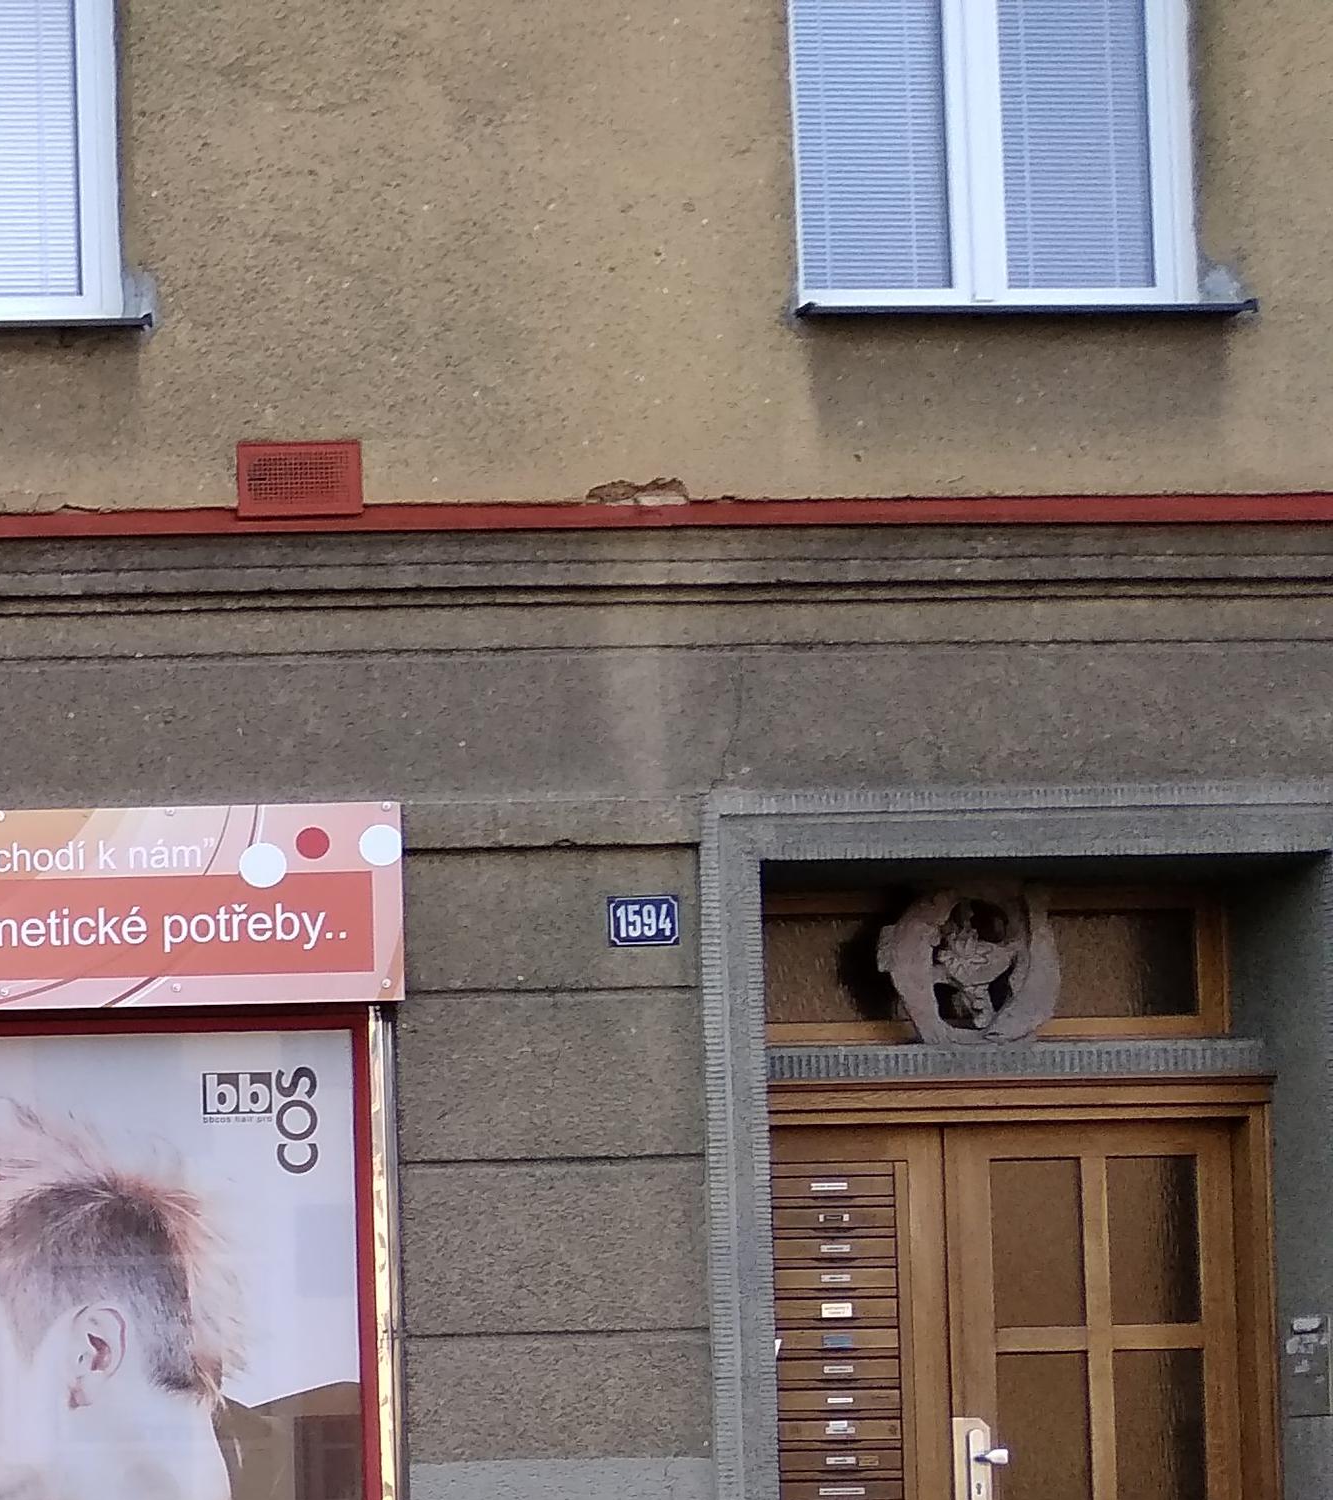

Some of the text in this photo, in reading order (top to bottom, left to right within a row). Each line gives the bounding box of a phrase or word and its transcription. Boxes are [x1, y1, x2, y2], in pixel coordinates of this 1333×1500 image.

[98, 840, 117, 870] k
[615, 903, 673, 938] 1594
[205, 1073, 271, 1114] bb
